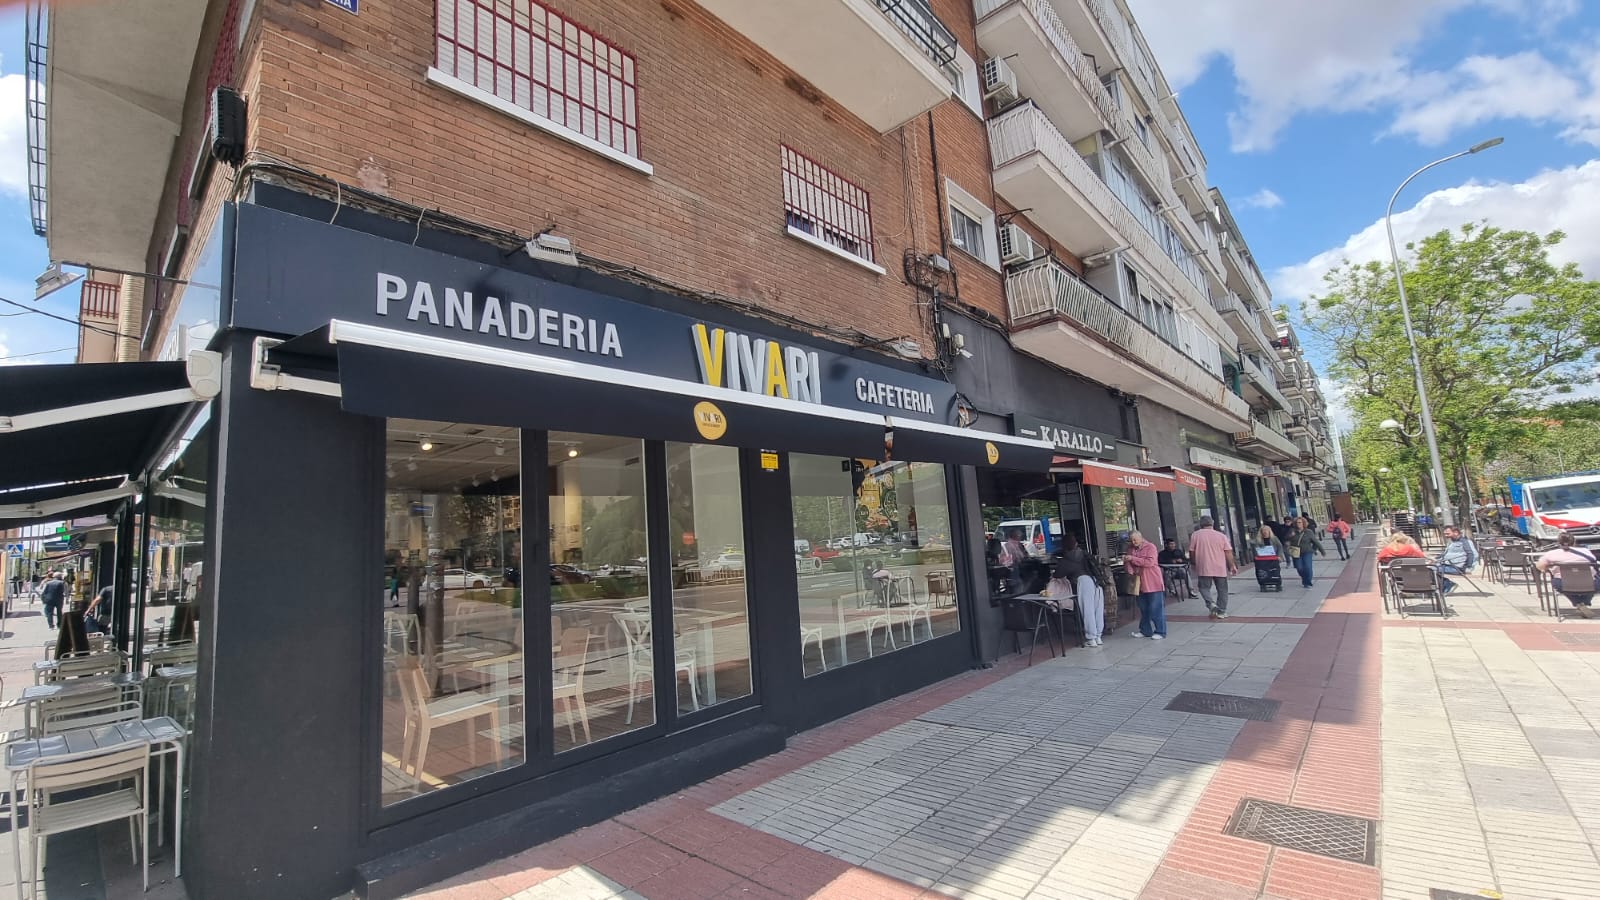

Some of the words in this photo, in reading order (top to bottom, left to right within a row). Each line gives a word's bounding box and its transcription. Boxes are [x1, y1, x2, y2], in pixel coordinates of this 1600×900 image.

[376, 272, 623, 358] PANADERIA
[692, 323, 822, 405] VIVARI
[856, 377, 935, 415] CAFETERIA
[1040, 426, 1103, 453] KARALLO
